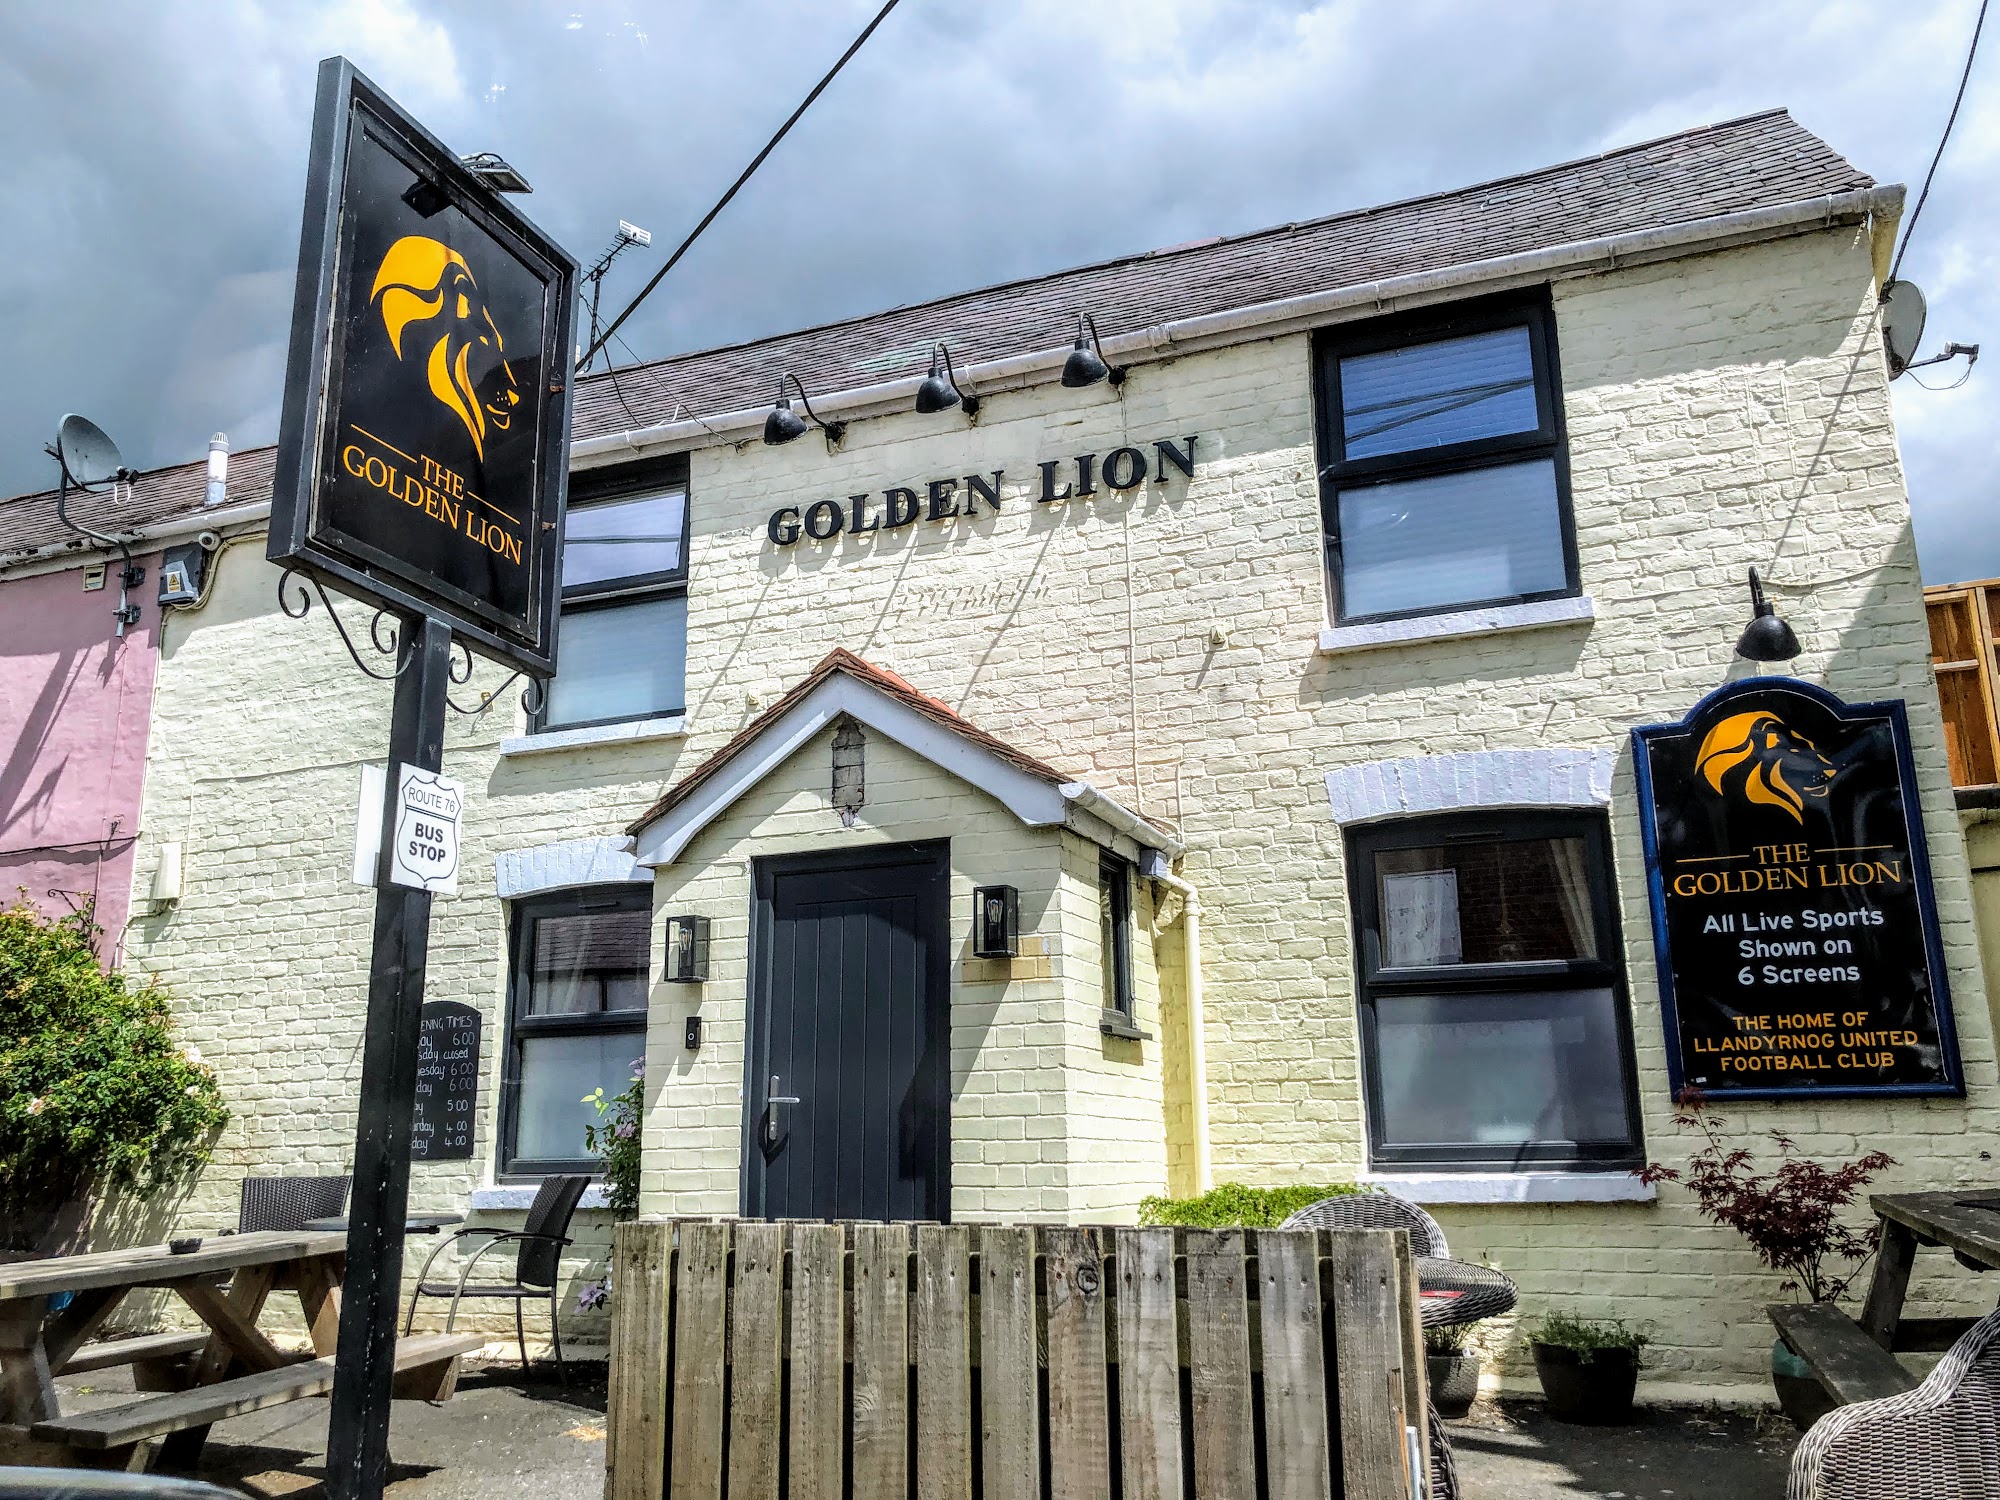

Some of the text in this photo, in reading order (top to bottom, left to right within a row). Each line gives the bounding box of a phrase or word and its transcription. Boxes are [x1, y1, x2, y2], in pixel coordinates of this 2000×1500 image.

[420, 453, 465, 500] THE
[767, 435, 1199, 546] GOLDEN LION
[342, 445, 523, 566] GOLDEN LION
[408, 787, 456, 813] ROUTE 76
[415, 822, 444, 843] BUS
[408, 841, 446, 862] STOP
[1753, 843, 1811, 866] THE
[1673, 860, 1902, 896] GOLDEN LION
[1703, 906, 1884, 934] All Live Sports
[1738, 939, 1852, 958] Shown on
[1738, 965, 1861, 985] 6 Screens
[421, 1015, 473, 1032] ENING TIMES
[1732, 1011, 1869, 1030] THE HOME OF
[1694, 1030, 1919, 1053] LLANDYRNOG UNITED
[1721, 1052, 1895, 1072] FOOTBALL CLUB
